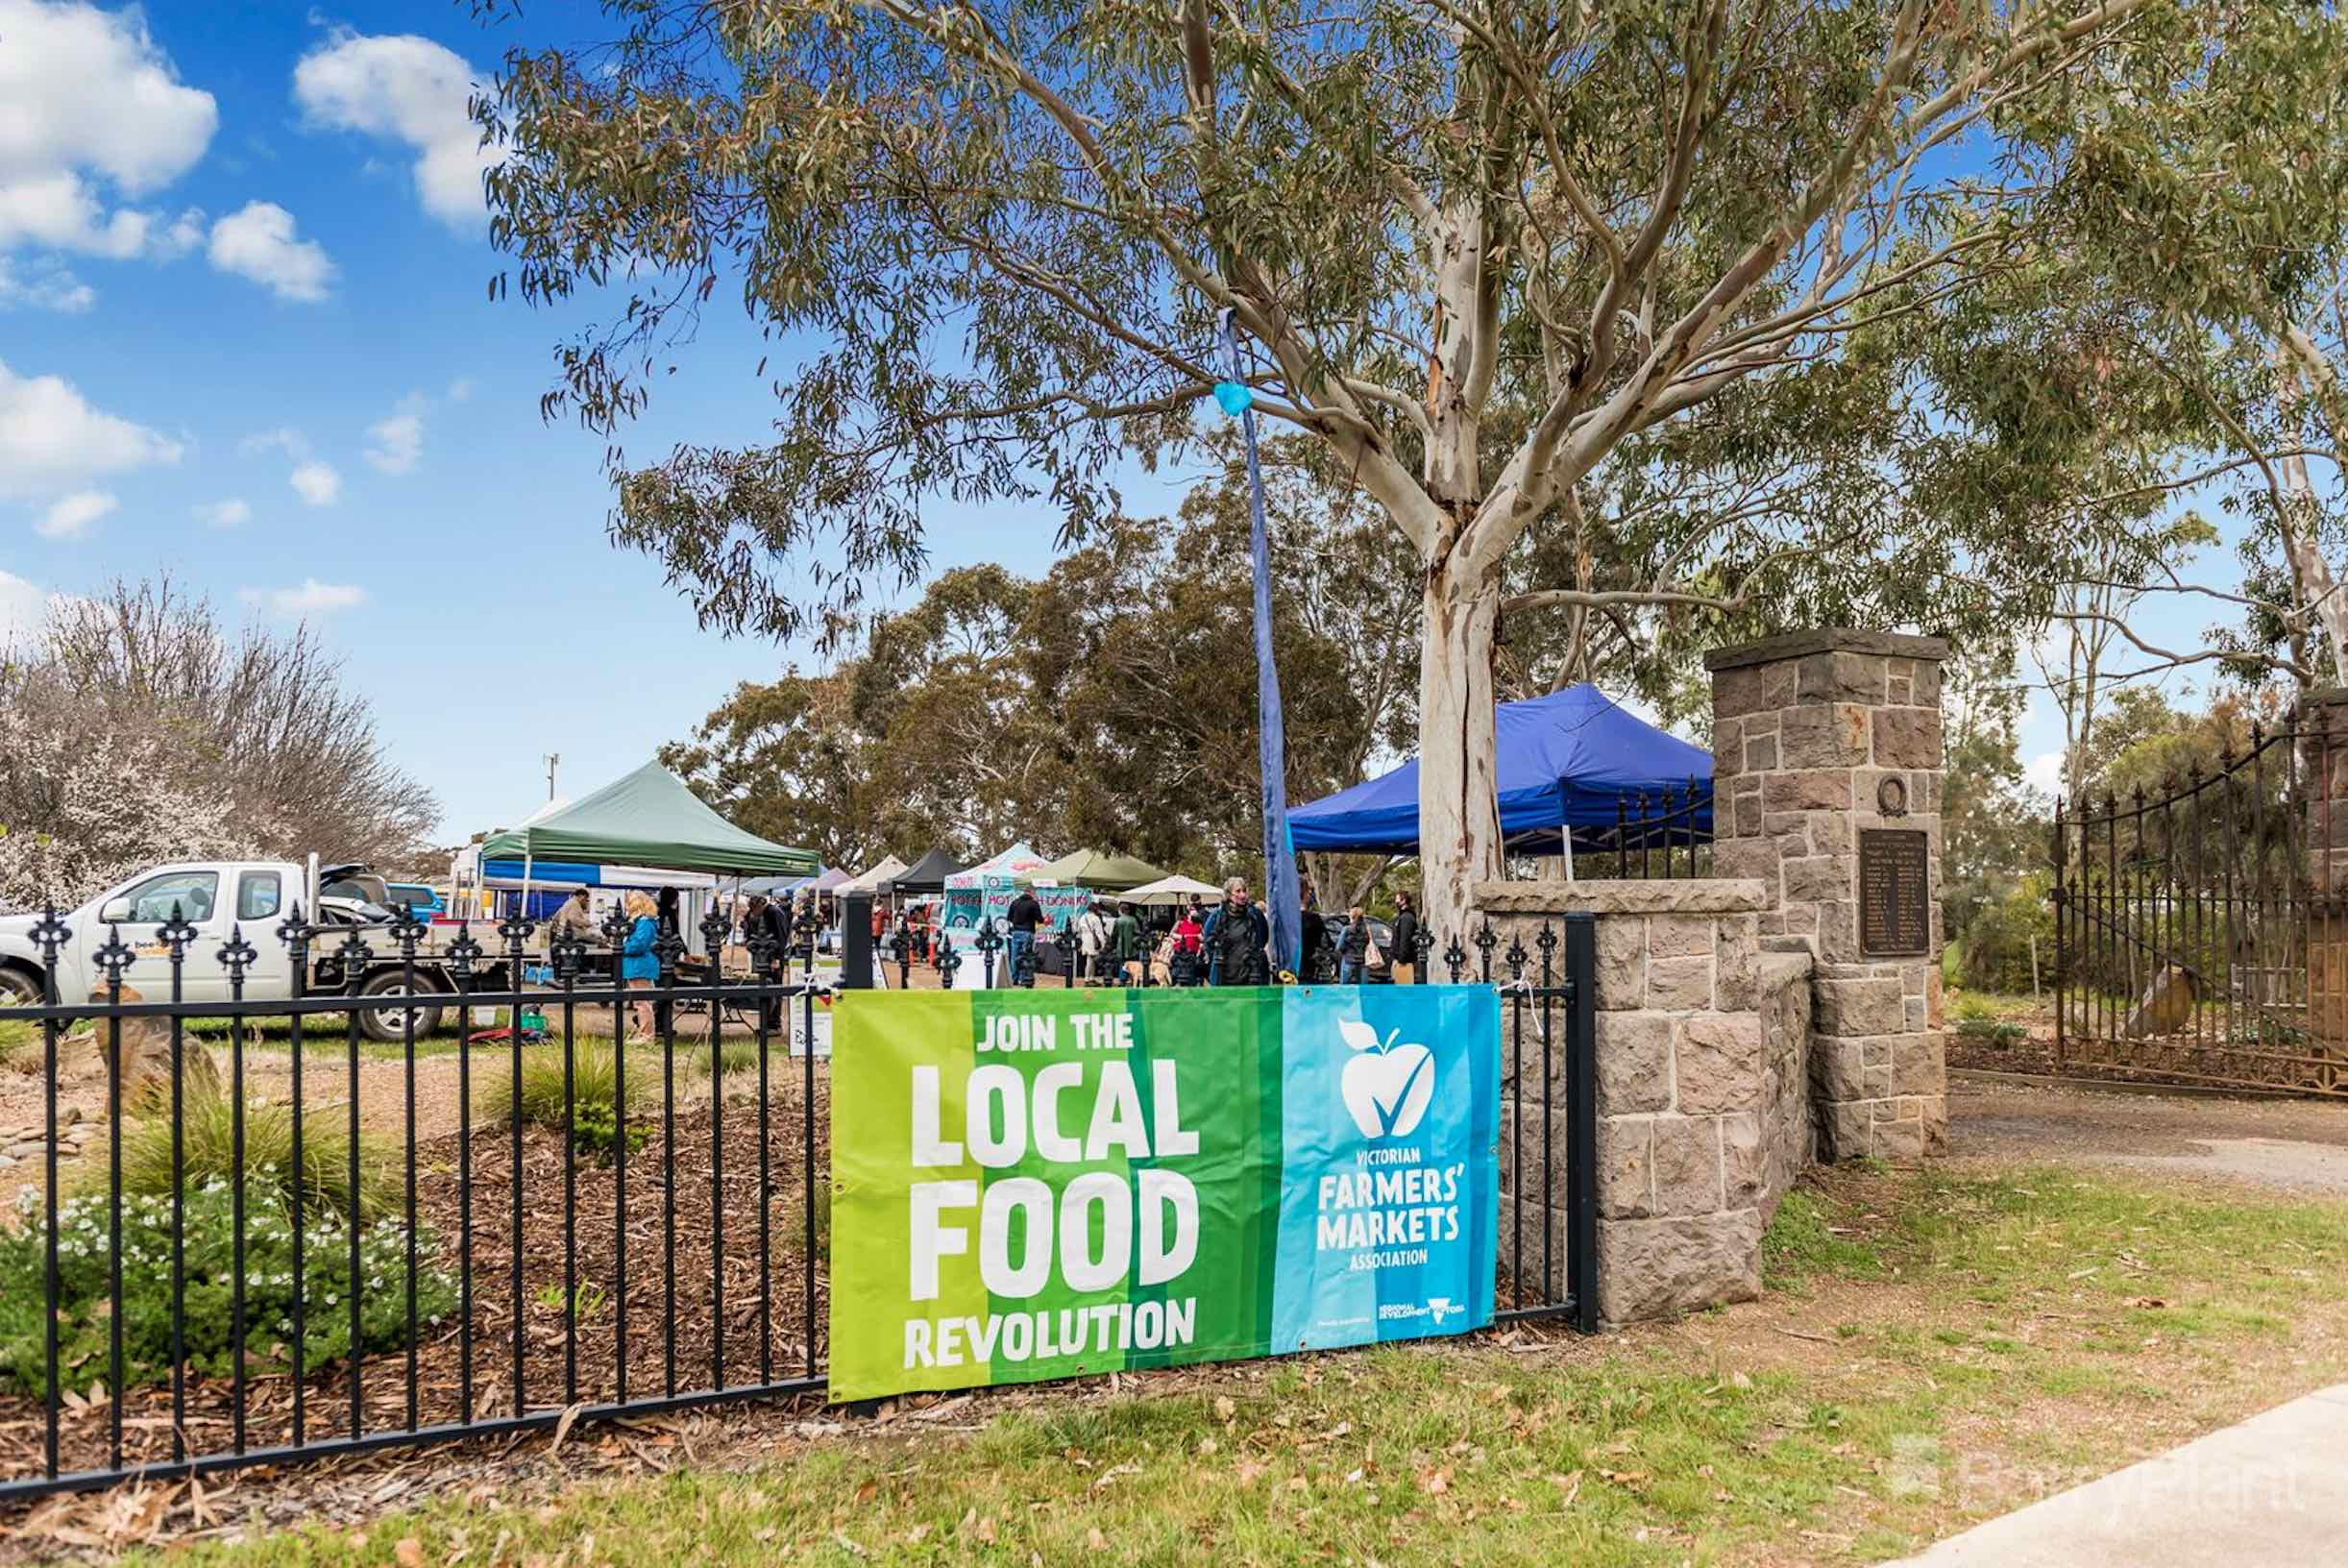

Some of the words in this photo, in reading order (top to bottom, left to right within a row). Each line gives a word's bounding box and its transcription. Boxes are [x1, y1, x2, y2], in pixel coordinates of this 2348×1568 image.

[976, 1014, 1056, 1052] JOIN
[1069, 1014, 1134, 1049] THE
[912, 1059, 1199, 1168] LOCAL
[1357, 1147, 1421, 1165] VICTORIAN
[1318, 1163, 1465, 1210] FARMERS'
[910, 1168, 1199, 1301] FOOD
[1316, 1205, 1459, 1251] MARKETS
[1349, 1249, 1429, 1271] ASSOCIATION
[903, 1297, 1196, 1369] REVOLUTION
